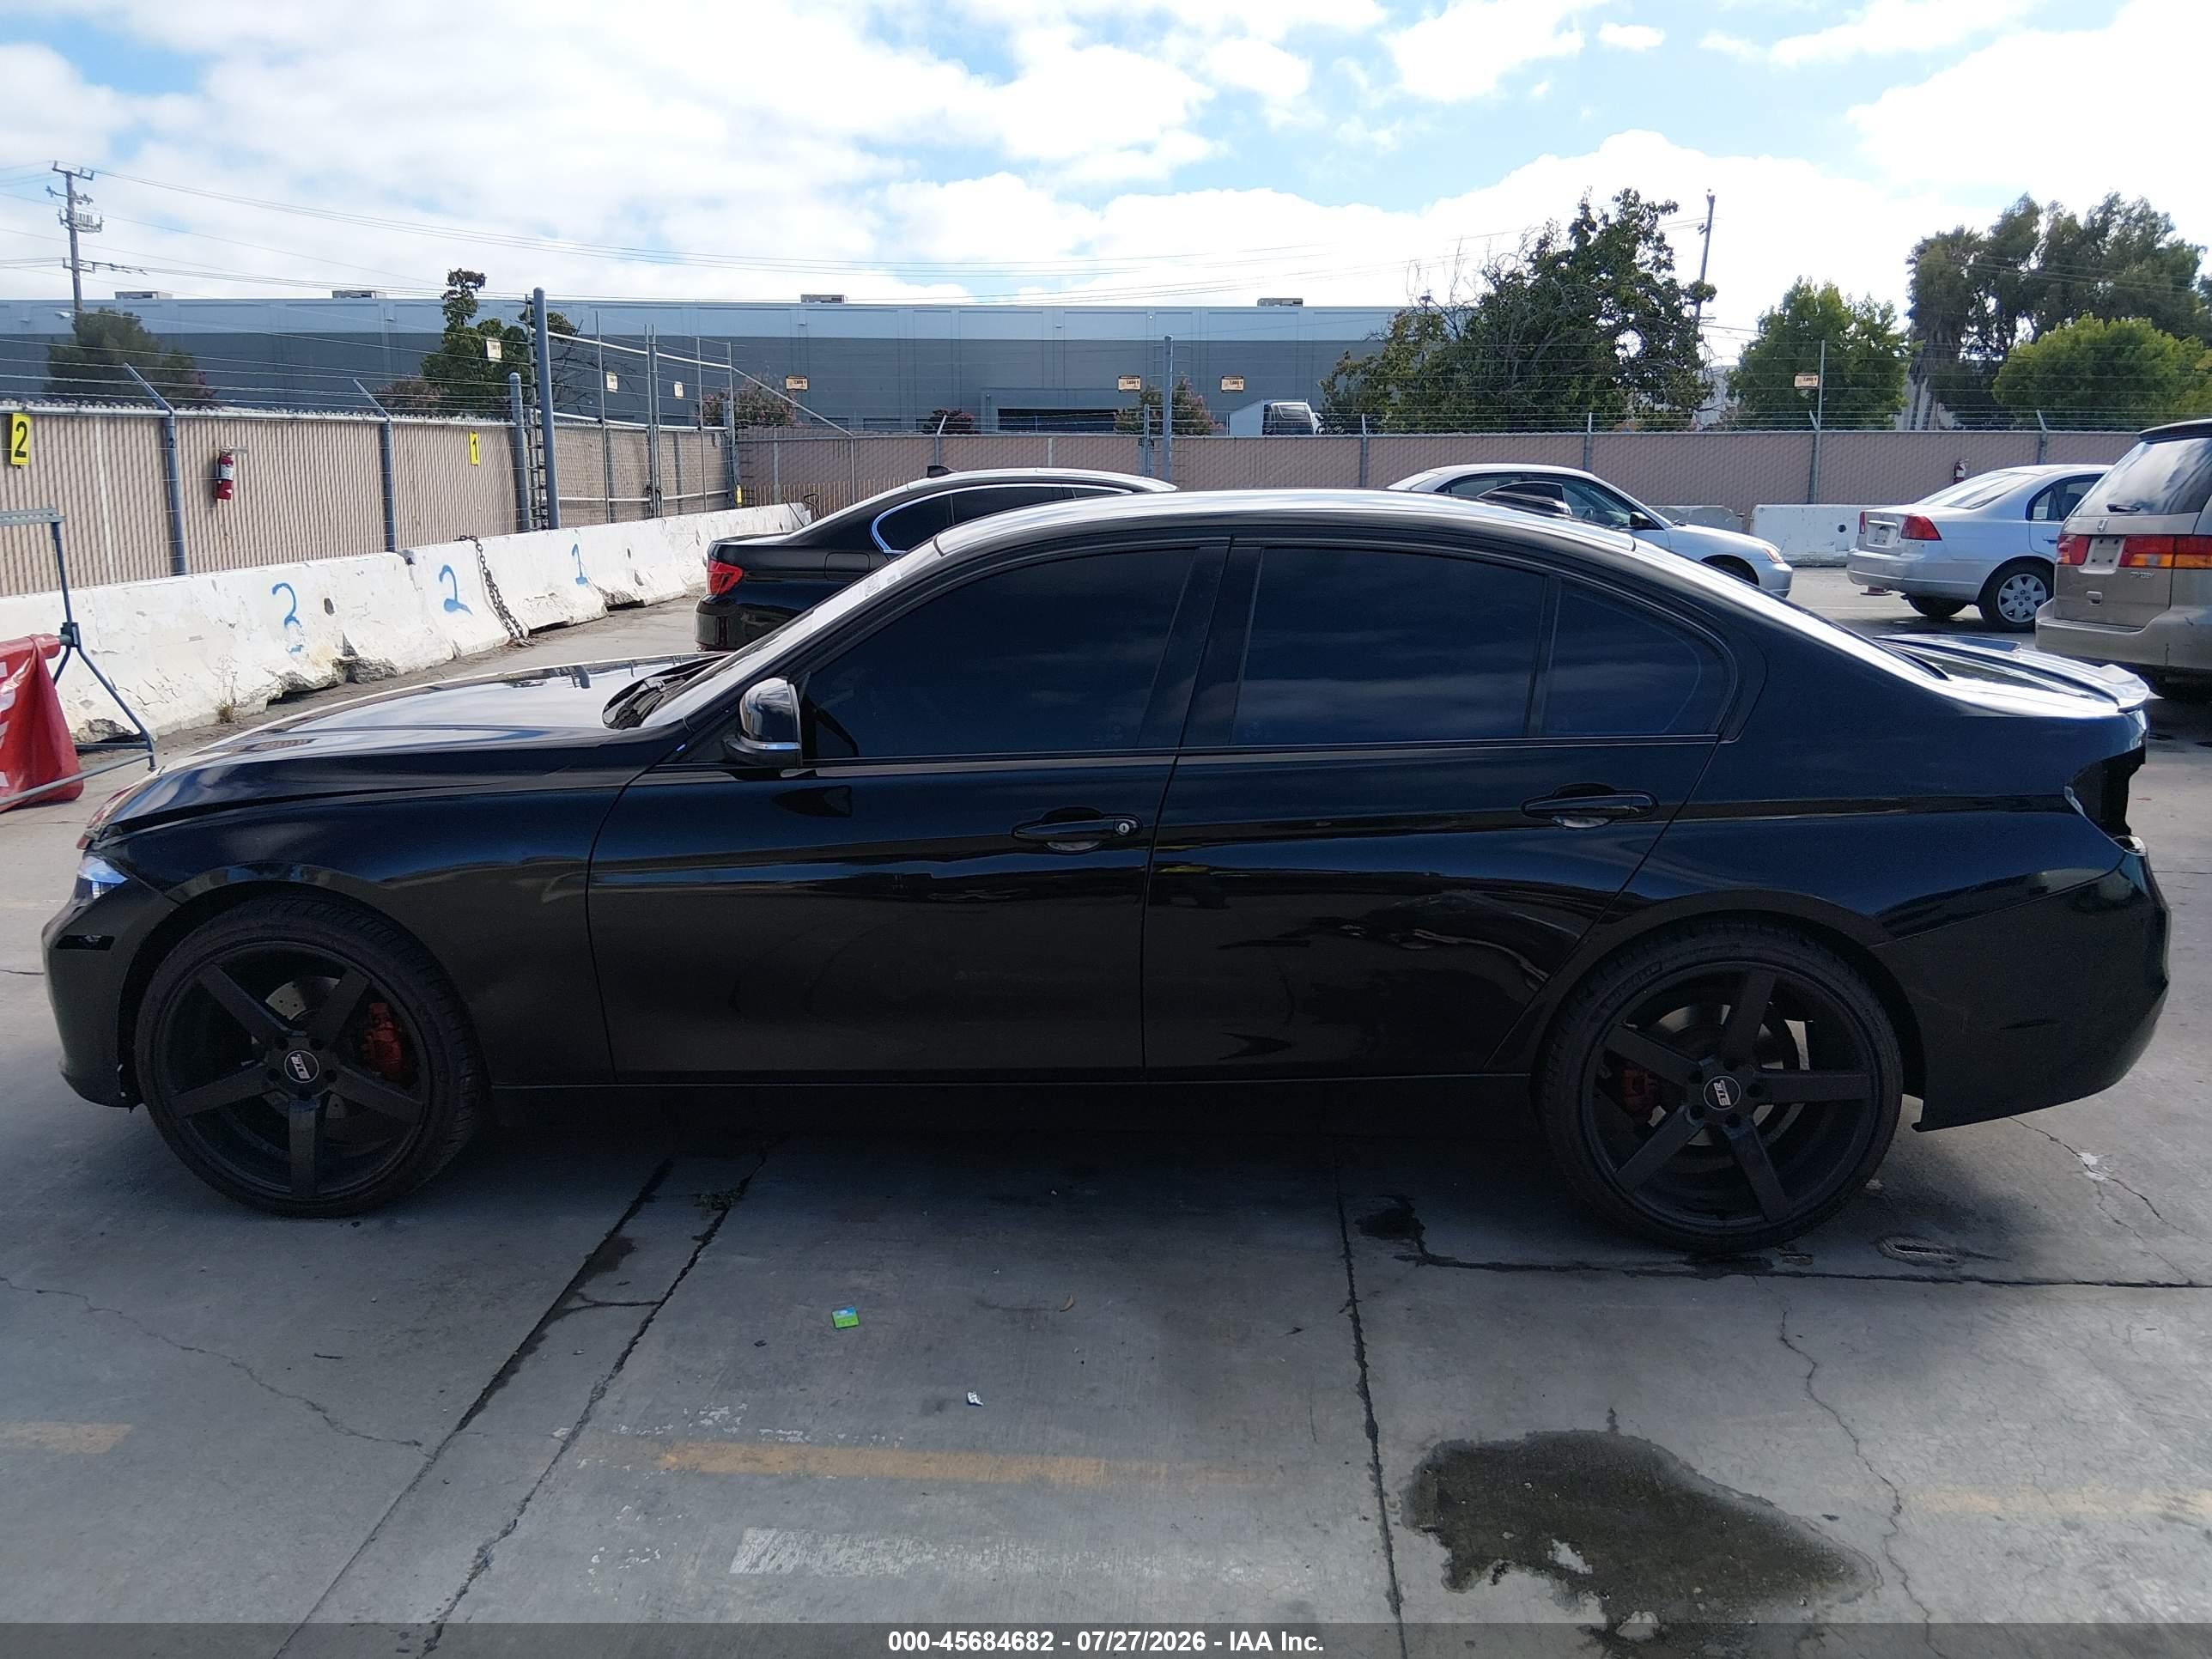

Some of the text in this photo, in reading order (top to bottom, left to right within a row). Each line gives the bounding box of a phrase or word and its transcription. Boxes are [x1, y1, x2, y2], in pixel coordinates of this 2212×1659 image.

[15, 421, 27, 458] 2
[472, 437, 478, 461] 1
[439, 564, 473, 615] 2
